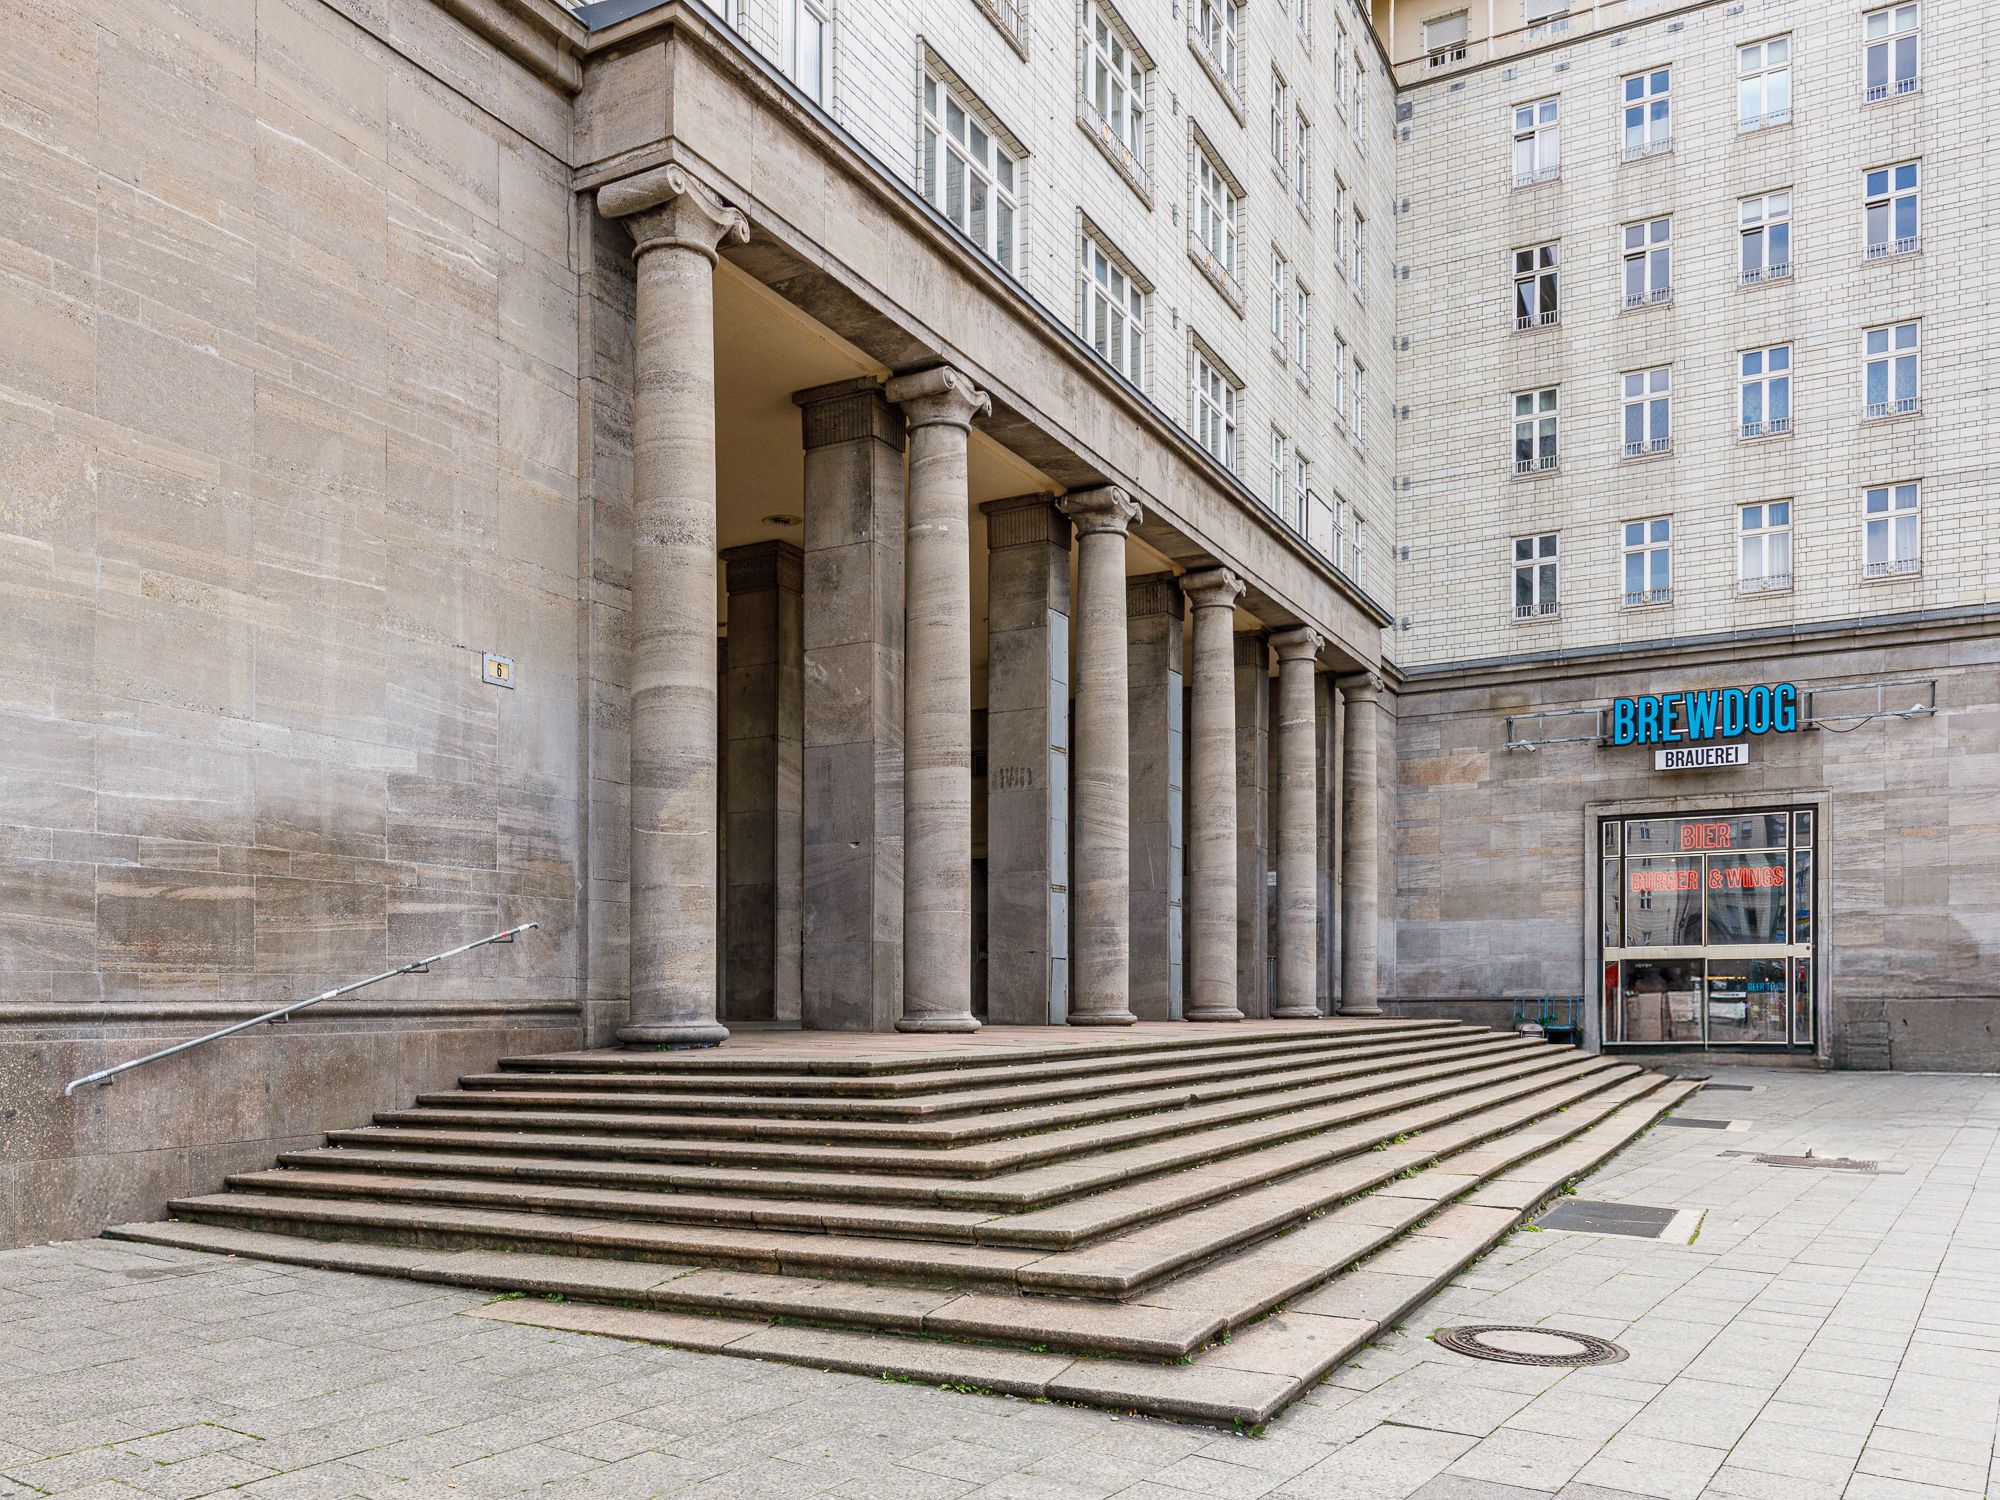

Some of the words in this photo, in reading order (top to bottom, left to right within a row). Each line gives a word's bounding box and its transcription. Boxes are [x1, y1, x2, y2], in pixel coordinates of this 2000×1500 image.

[497, 663, 502, 677] 6
[1613, 682, 1798, 747] BREWDOG
[1665, 746, 1739, 768] BRAUEREI
[1681, 823, 1731, 849] BIER
[1631, 870, 1699, 892] BURGER
[1708, 868, 1723, 889] &
[1725, 866, 1785, 888] WINGS
[1747, 983, 1764, 991] BEER
